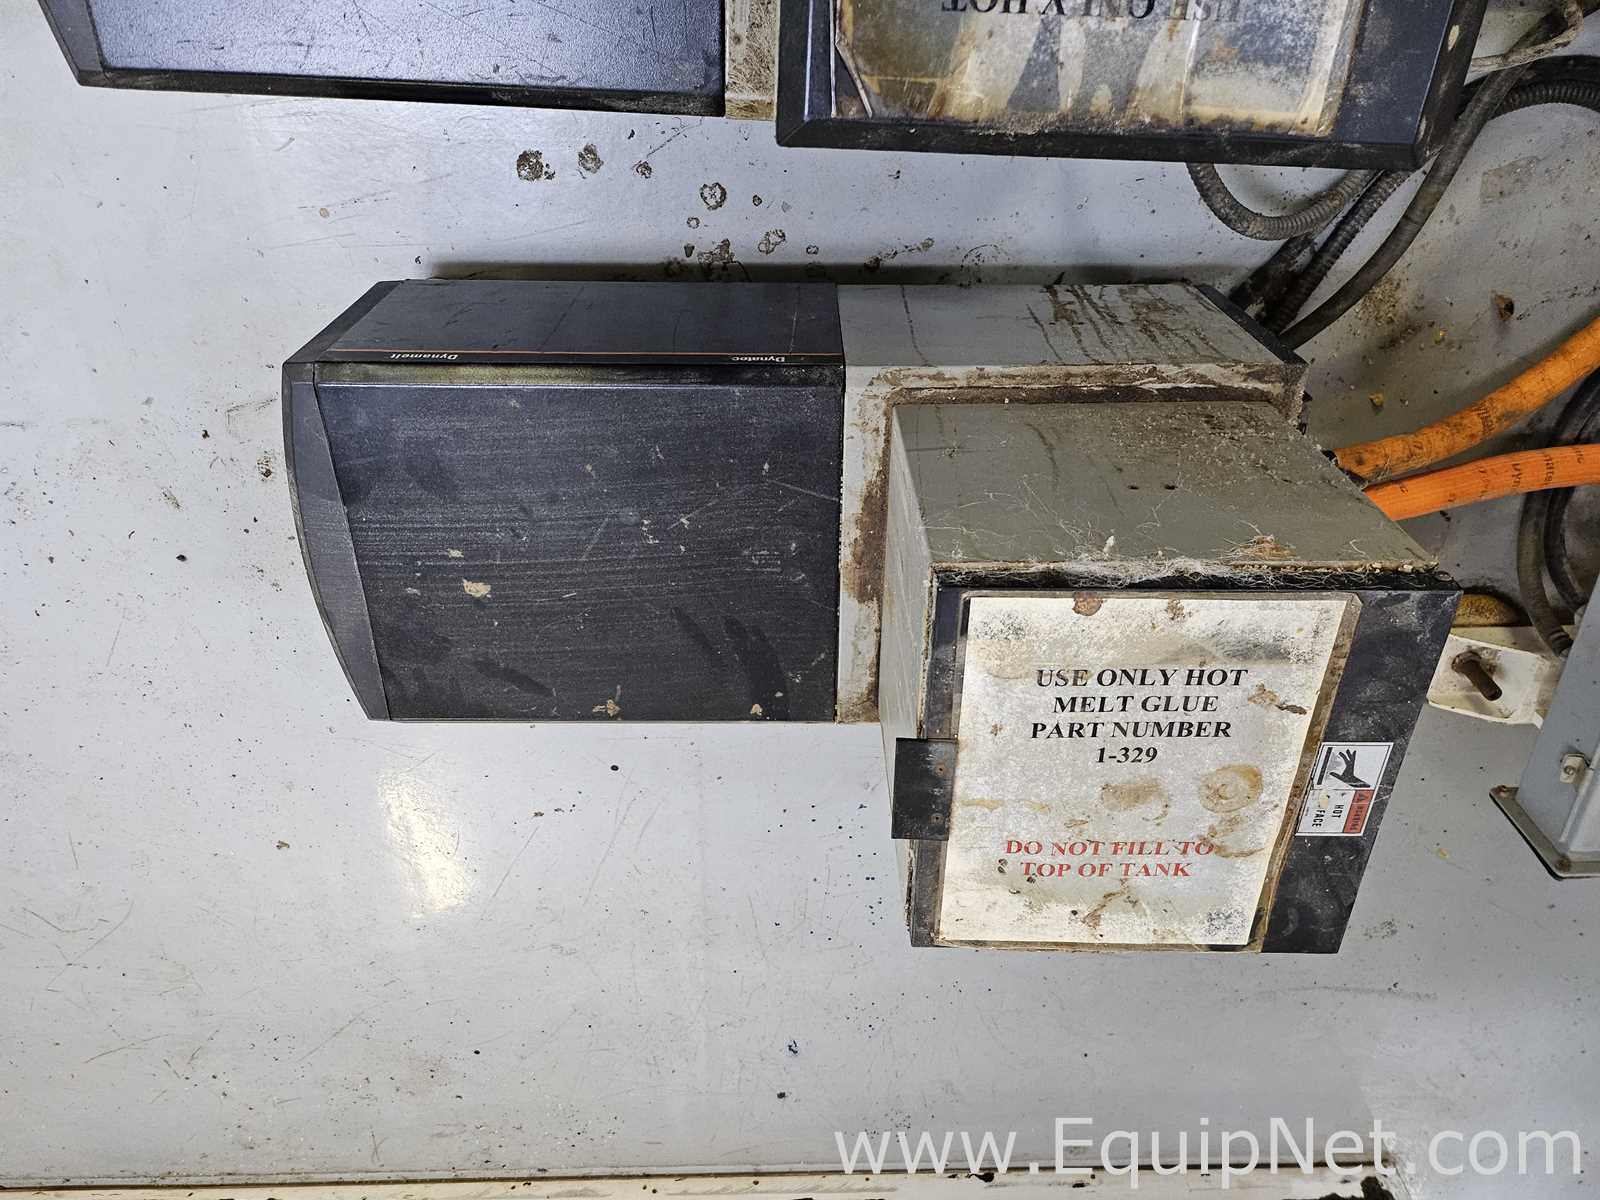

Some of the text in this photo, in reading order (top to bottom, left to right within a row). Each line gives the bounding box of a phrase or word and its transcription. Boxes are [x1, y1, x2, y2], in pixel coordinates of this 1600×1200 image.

[1036, 668, 1249, 687] USE ONLY HOT
[1052, 695, 1218, 713] MELT GLUE
[1031, 721, 1232, 739] PART NUMBER
[1096, 747, 1158, 763] 1-329
[1332, 804, 1344, 818] HOT
[1006, 839, 1214, 856] DO NOT FILL TO
[1020, 862, 1193, 877] TOP OF TANK
